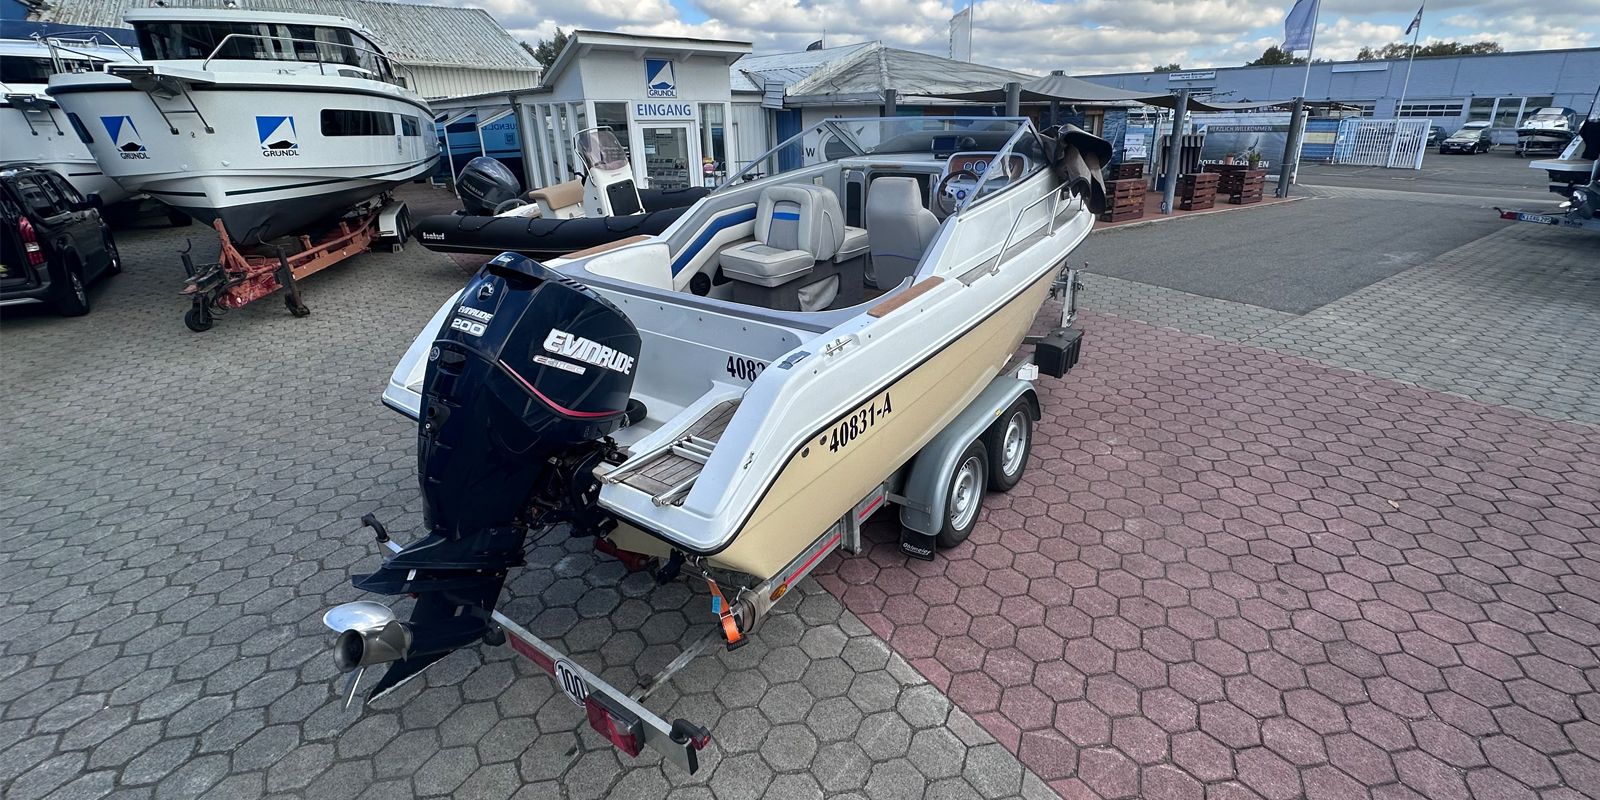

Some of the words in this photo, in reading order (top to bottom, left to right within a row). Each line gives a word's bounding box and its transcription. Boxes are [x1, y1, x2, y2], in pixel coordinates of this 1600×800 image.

[637, 104, 692, 116] EINGANG
[805, 148, 816, 157] W
[457, 305, 494, 322] EVINRUDE
[451, 317, 487, 338] 200
[543, 327, 635, 376] EVINRUDE
[829, 391, 893, 453] 40831-A
[557, 664, 587, 702] 100
